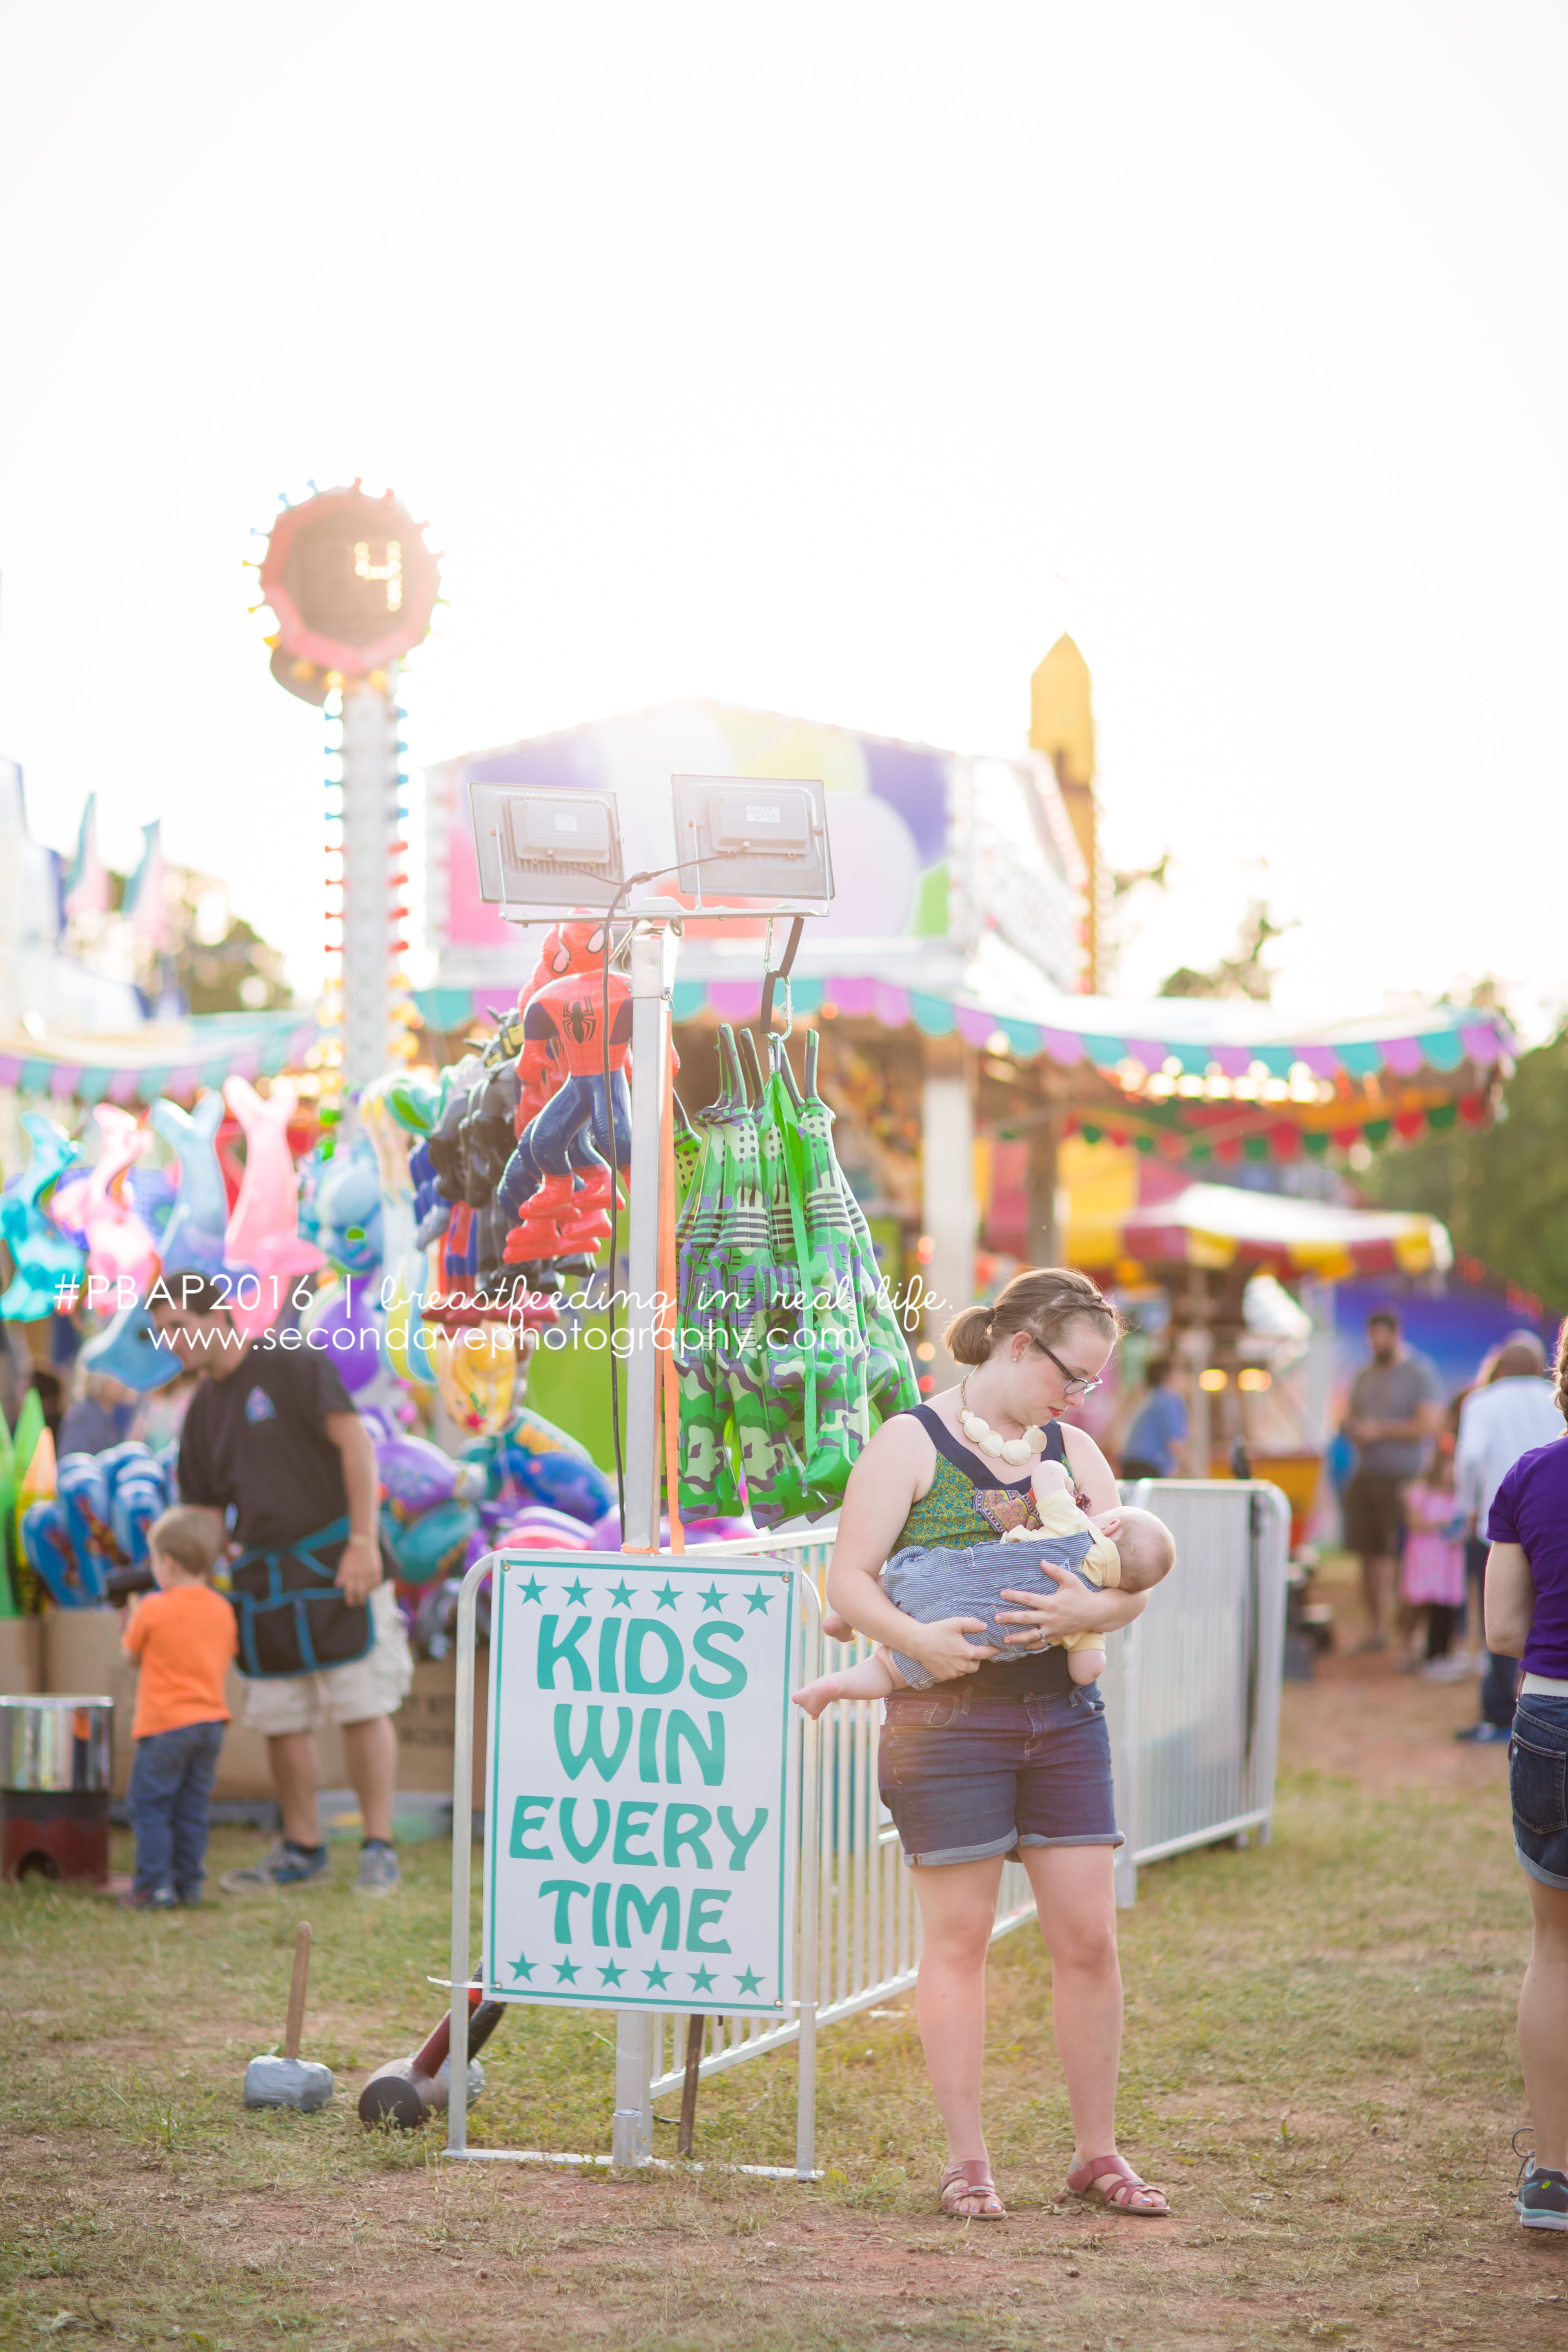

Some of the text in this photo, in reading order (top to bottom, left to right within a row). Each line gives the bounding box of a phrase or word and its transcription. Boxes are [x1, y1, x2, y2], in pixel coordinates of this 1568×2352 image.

[354, 540, 403, 611] 4
[537, 1614, 747, 1699] KIDS
[554, 1704, 725, 1786] WIN
[509, 1795, 768, 1871] EVERY
[538, 1880, 732, 1953] TIME
